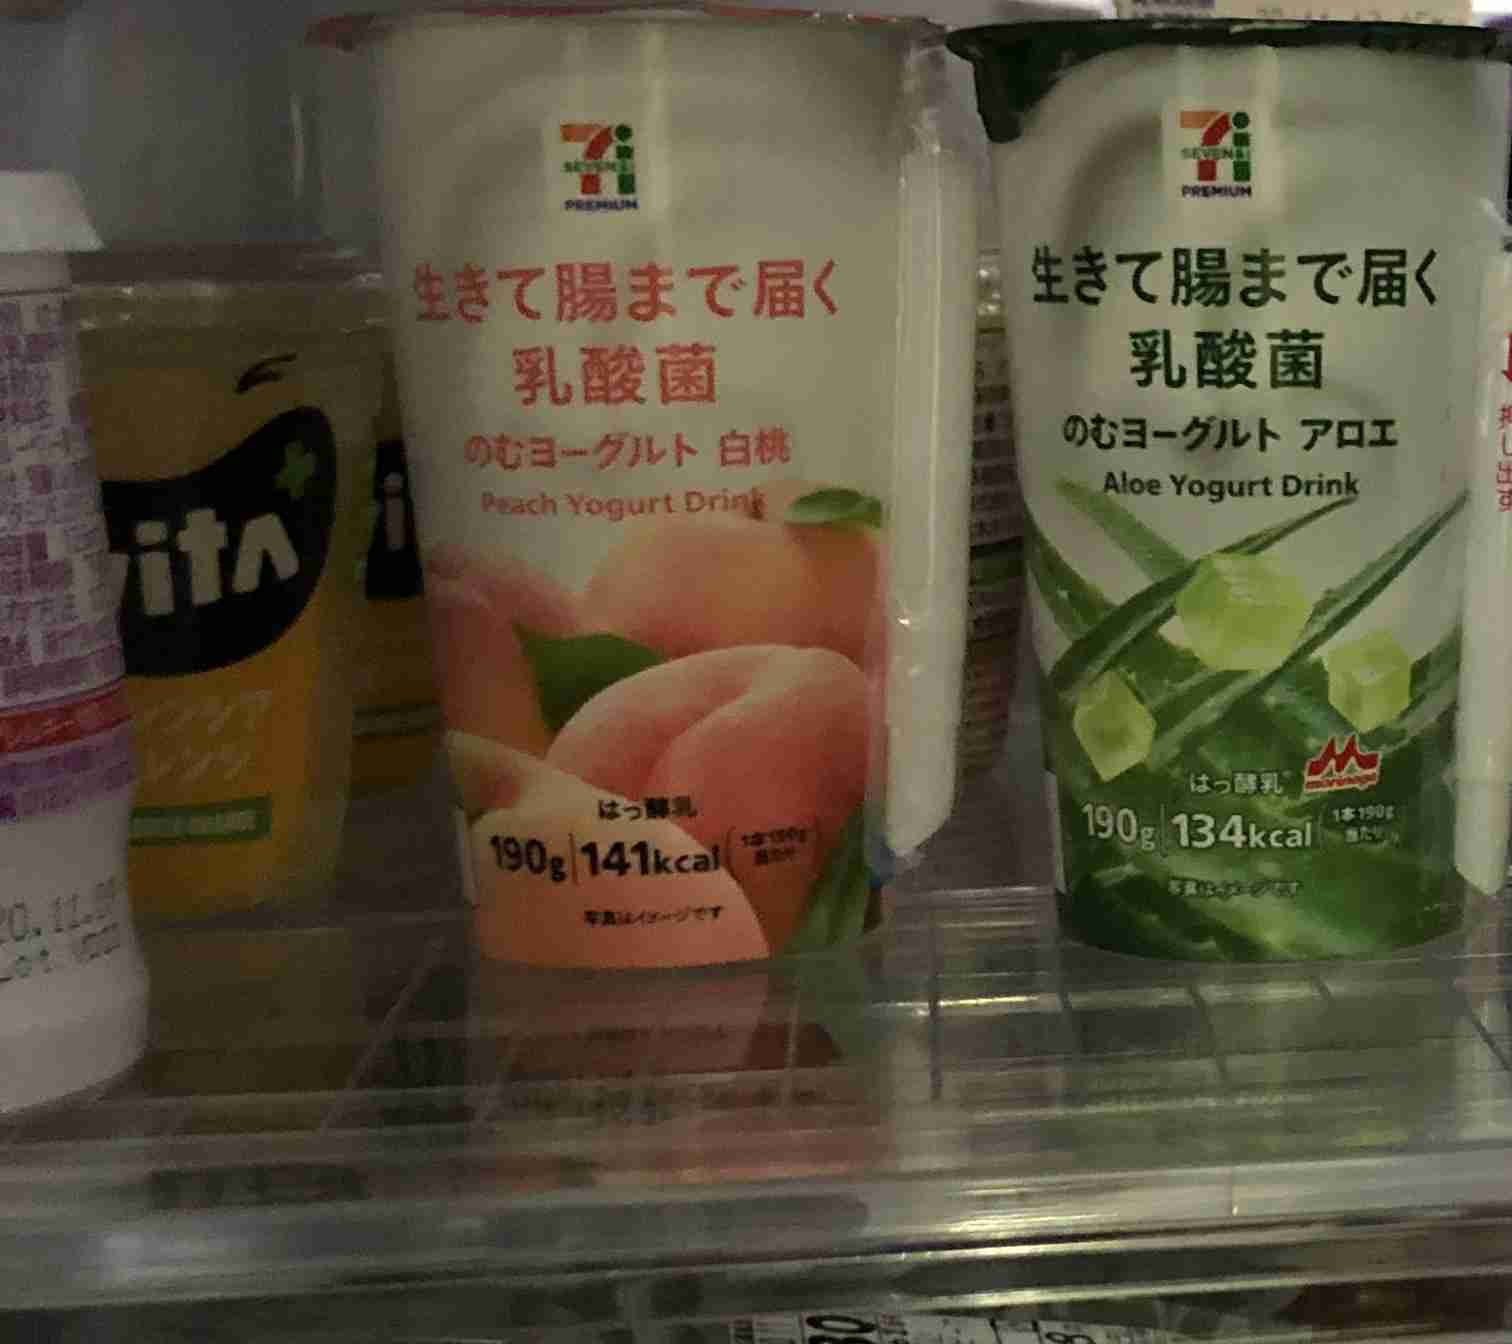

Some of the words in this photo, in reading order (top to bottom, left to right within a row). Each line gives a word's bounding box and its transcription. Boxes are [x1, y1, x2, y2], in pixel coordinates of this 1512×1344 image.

[564, 198, 639, 213] PREMIUM
[1180, 184, 1253, 199] PREMIUM
[414, 258, 839, 324] 生きて腸まで届く
[1030, 245, 1438, 308] 生きて腸まで届く
[512, 342, 718, 407] 乳酸菌
[1128, 327, 1326, 390] 乳酸菌
[463, 430, 699, 472] のむヨーグルト
[718, 424, 793, 467] 白桃
[1062, 413, 1281, 452] のむヨーグルト
[1299, 417, 1399, 450] アロエ
[481, 491, 560, 518] Peach
[566, 490, 673, 523] Yogurt
[684, 487, 768, 517] Drink
[1102, 470, 1163, 498] Aloe
[1169, 470, 1273, 504] Yogurt
[1281, 470, 1360, 499] Drink
[1188, 770, 1284, 796] はっ酵乳
[1080, 801, 1156, 851] 190g
[1169, 812, 1313, 850] 134kcal
[487, 833, 568, 884] 190g
[580, 836, 721, 878] 141kcal
